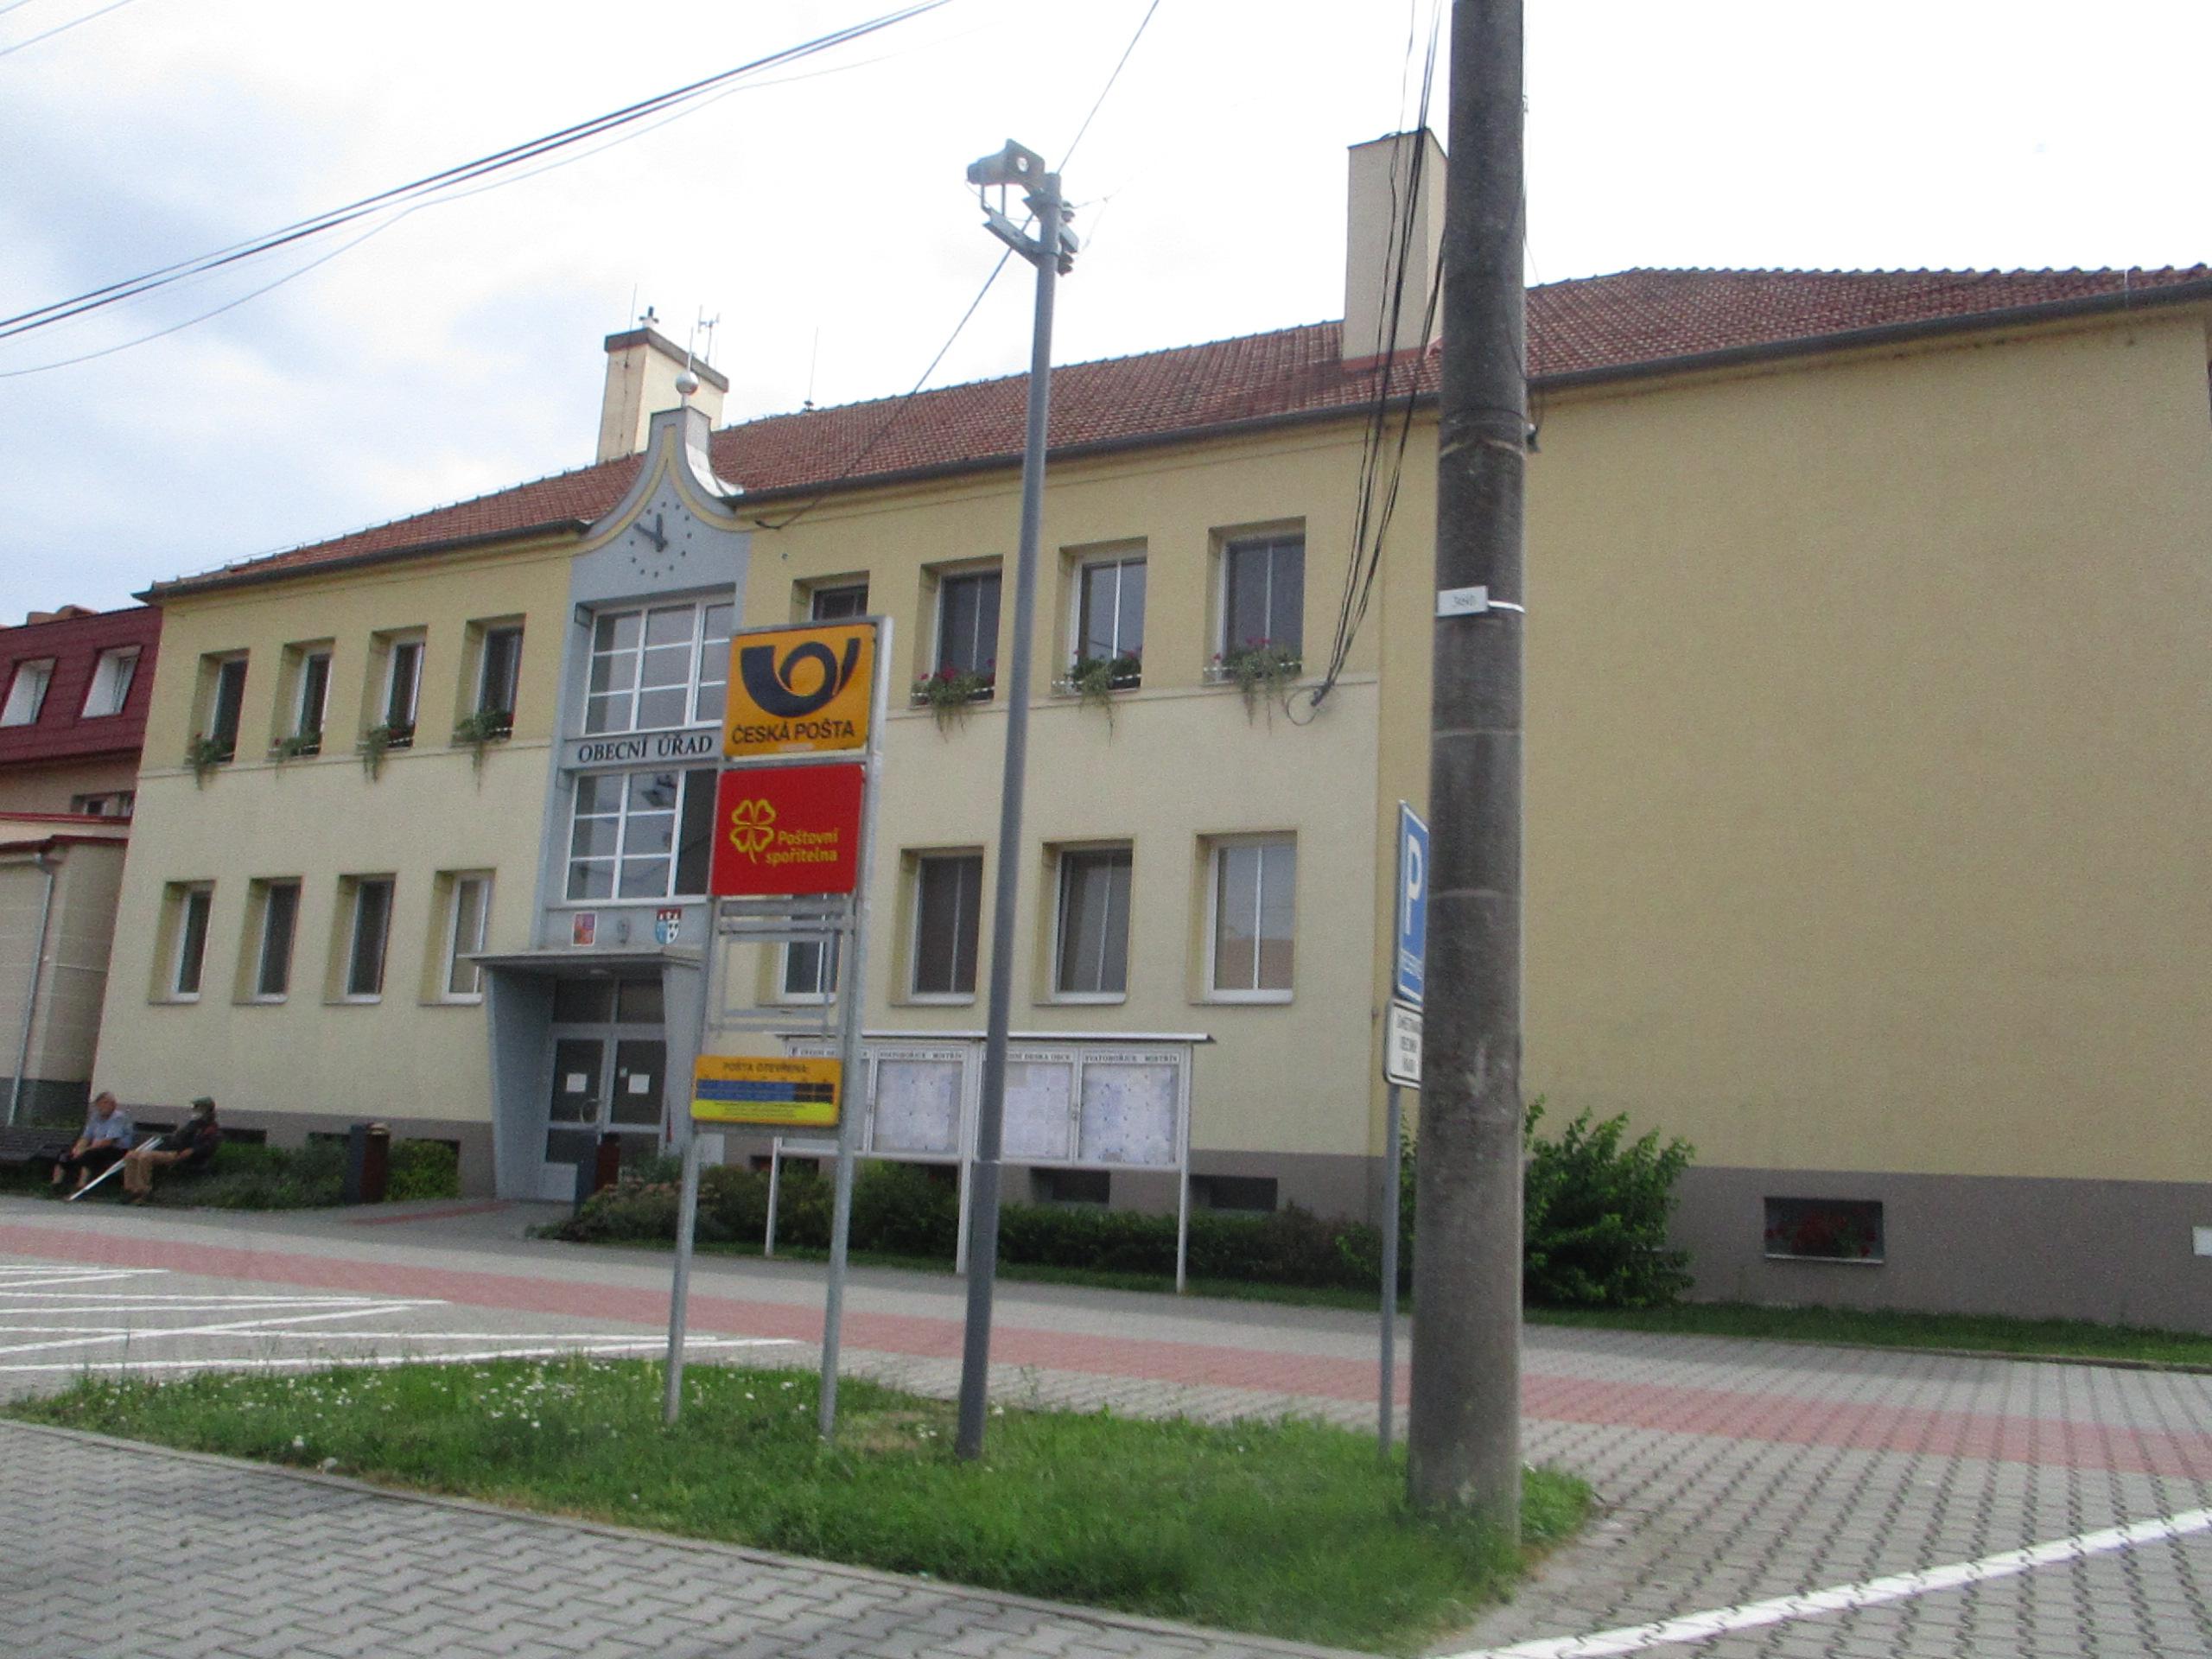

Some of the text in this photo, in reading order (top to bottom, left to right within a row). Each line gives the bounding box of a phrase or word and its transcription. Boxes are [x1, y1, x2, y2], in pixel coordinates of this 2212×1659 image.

[732, 718, 855, 744] ČESKÁ POŠTA
[578, 733, 712, 763] OBECNÍ ÚŘAD
[779, 828, 838, 845] Poštovní
[766, 847, 837, 867] spořitelna
[1405, 833, 1422, 936] P
